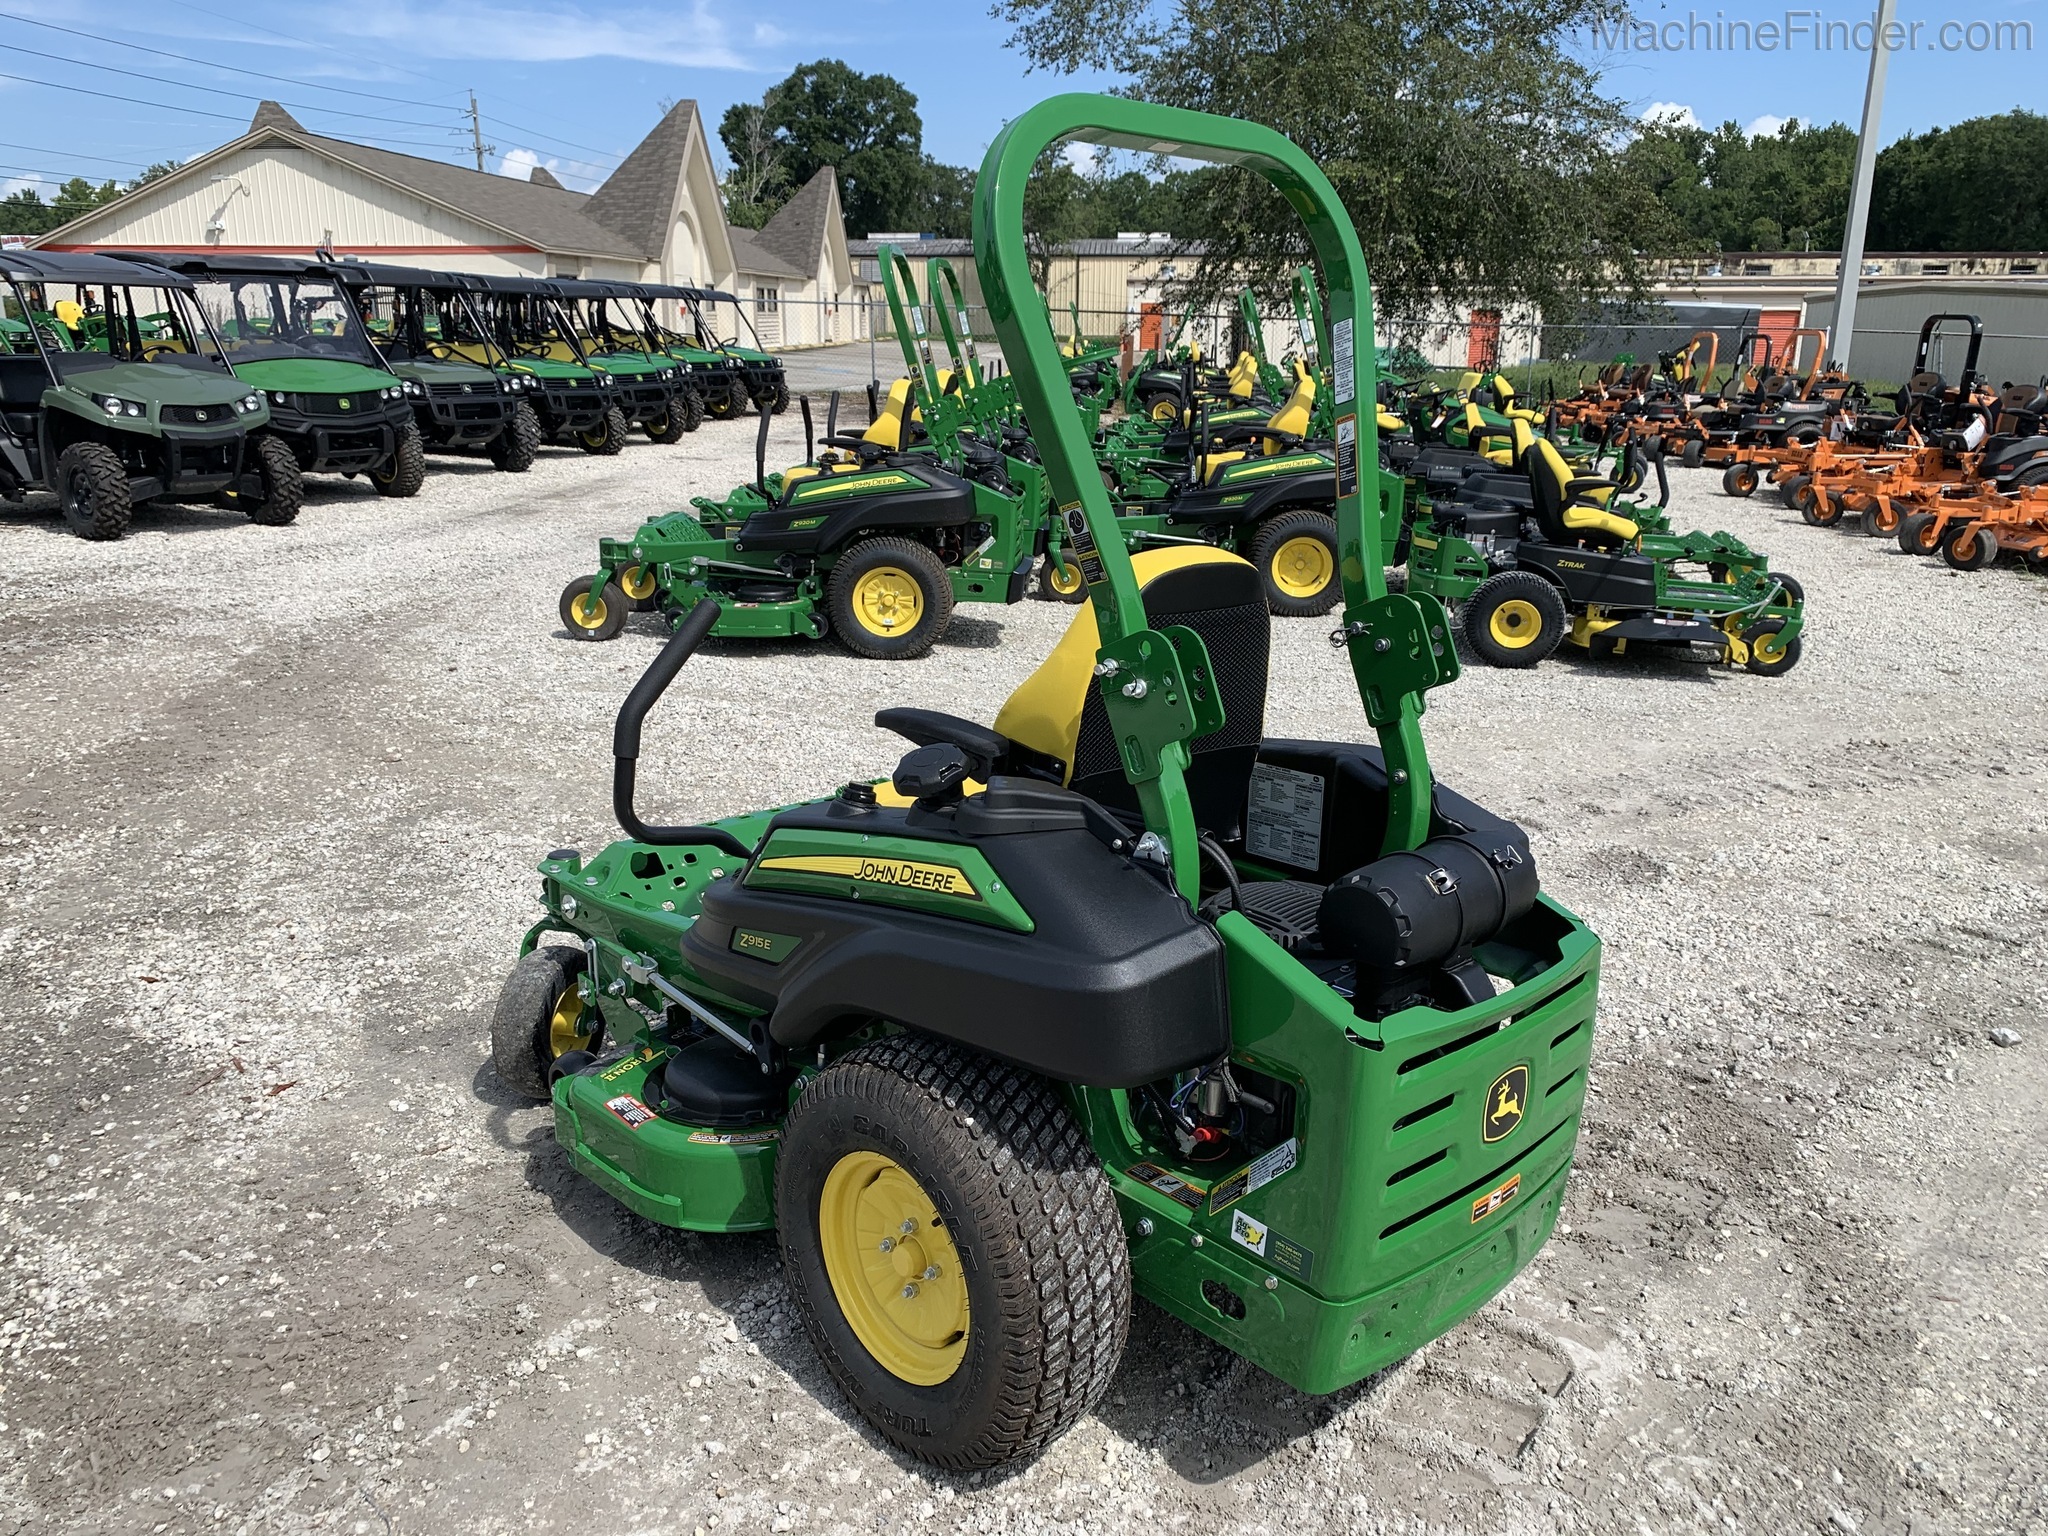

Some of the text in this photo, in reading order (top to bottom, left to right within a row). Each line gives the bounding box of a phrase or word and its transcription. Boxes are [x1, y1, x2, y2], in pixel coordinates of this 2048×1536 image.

[851, 477, 898, 489] JOHN DEERE
[1557, 559, 1586, 569] ZTRAK
[854, 860, 956, 891] JOHN DEERE
[739, 933, 772, 950] Z915E
[852, 1112, 980, 1272] CARLISLE
[1235, 1225, 1250, 1239] Pro
[865, 1399, 935, 1439] TURF
